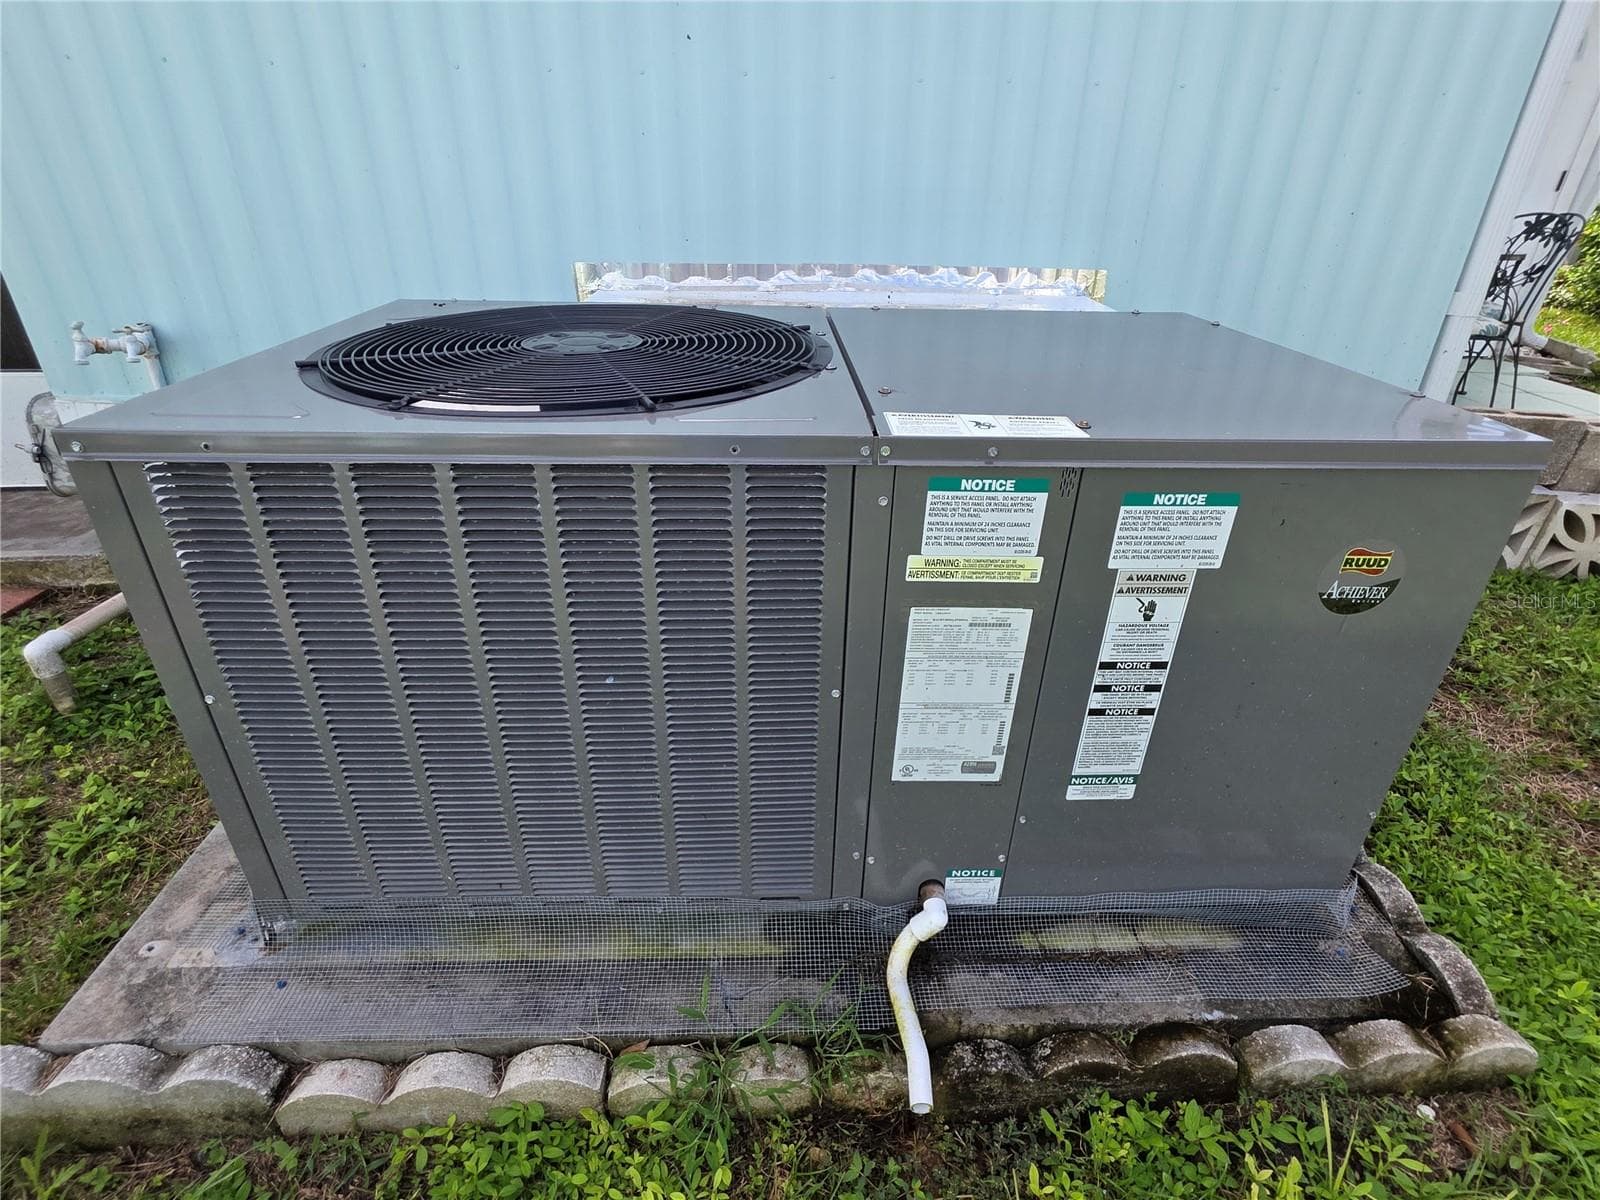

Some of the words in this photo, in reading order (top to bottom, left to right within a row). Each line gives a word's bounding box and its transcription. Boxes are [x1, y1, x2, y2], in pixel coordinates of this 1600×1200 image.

[960, 479, 1016, 491] NOTICE
[1153, 494, 1207, 505] NOTICE
[1343, 557, 1389, 568] RUUD
[1071, 776, 1134, 785] NOTICE/AVIS
